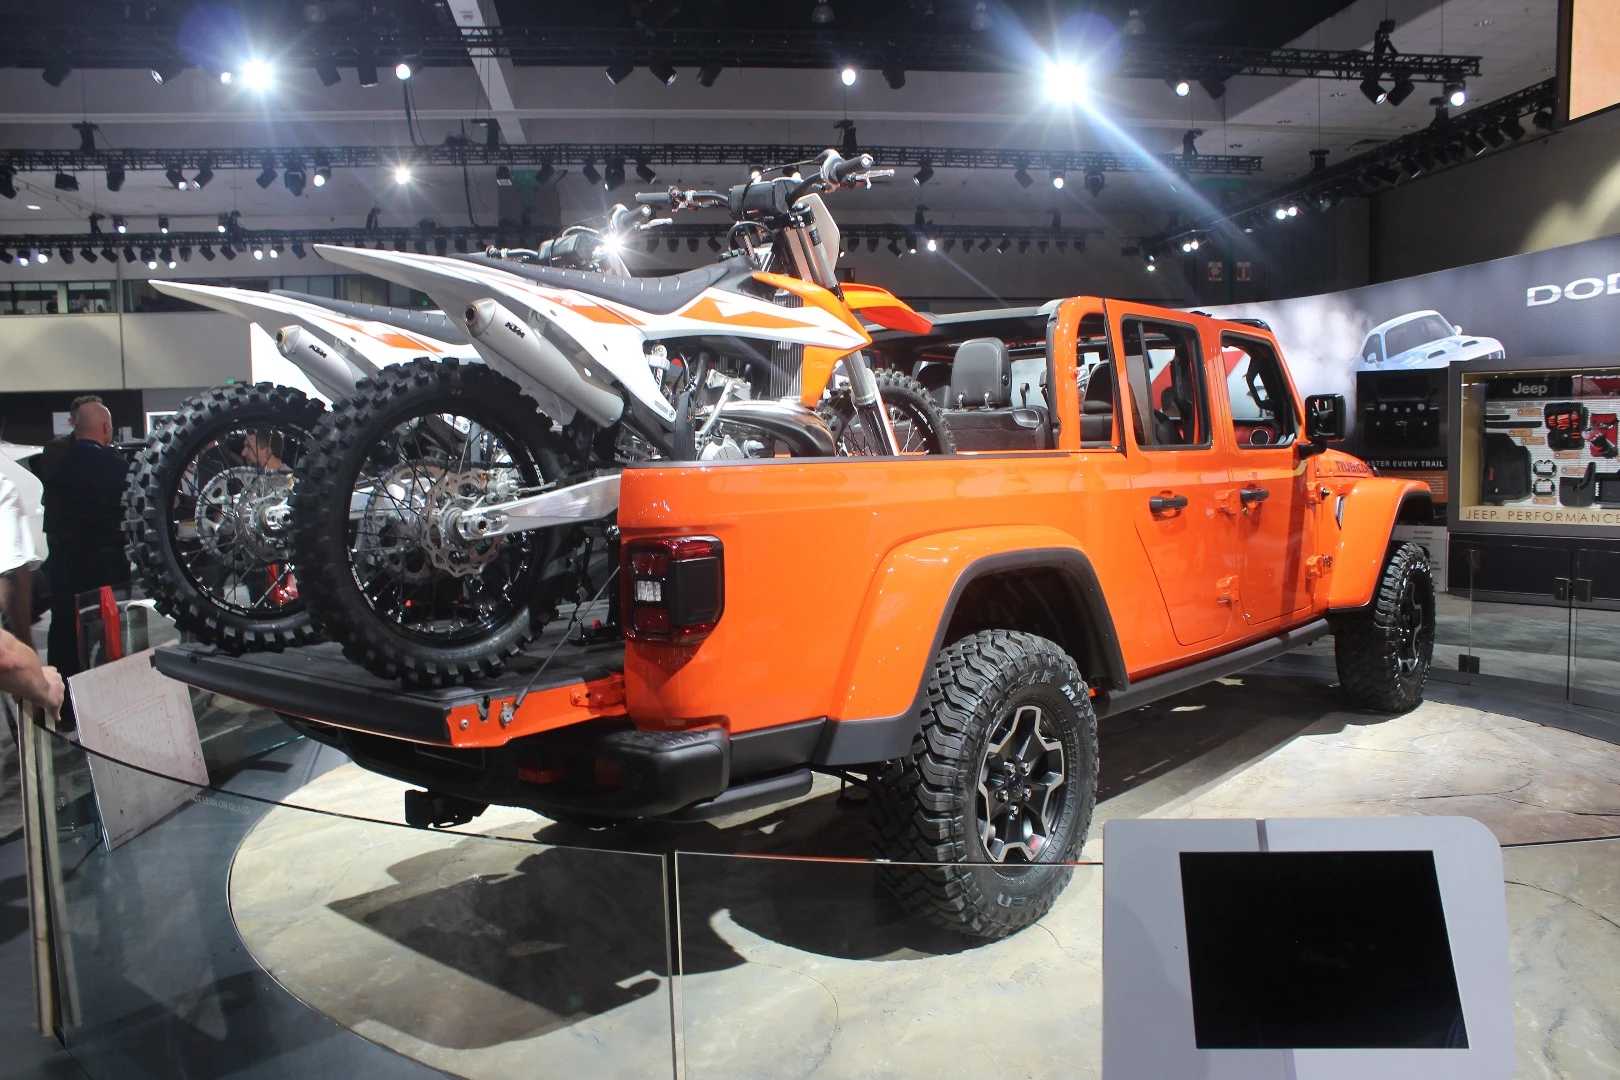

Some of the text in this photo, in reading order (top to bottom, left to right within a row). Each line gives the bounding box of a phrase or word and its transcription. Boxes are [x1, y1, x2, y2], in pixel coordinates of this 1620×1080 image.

[505, 321, 526, 339] KTM
[309, 344, 328, 359] KTM
[1512, 382, 1548, 396] Jeep
[1392, 460, 1418, 468] EVERY
[1420, 460, 1444, 468] TRAIL
[229, 803, 250, 815] GLASS
